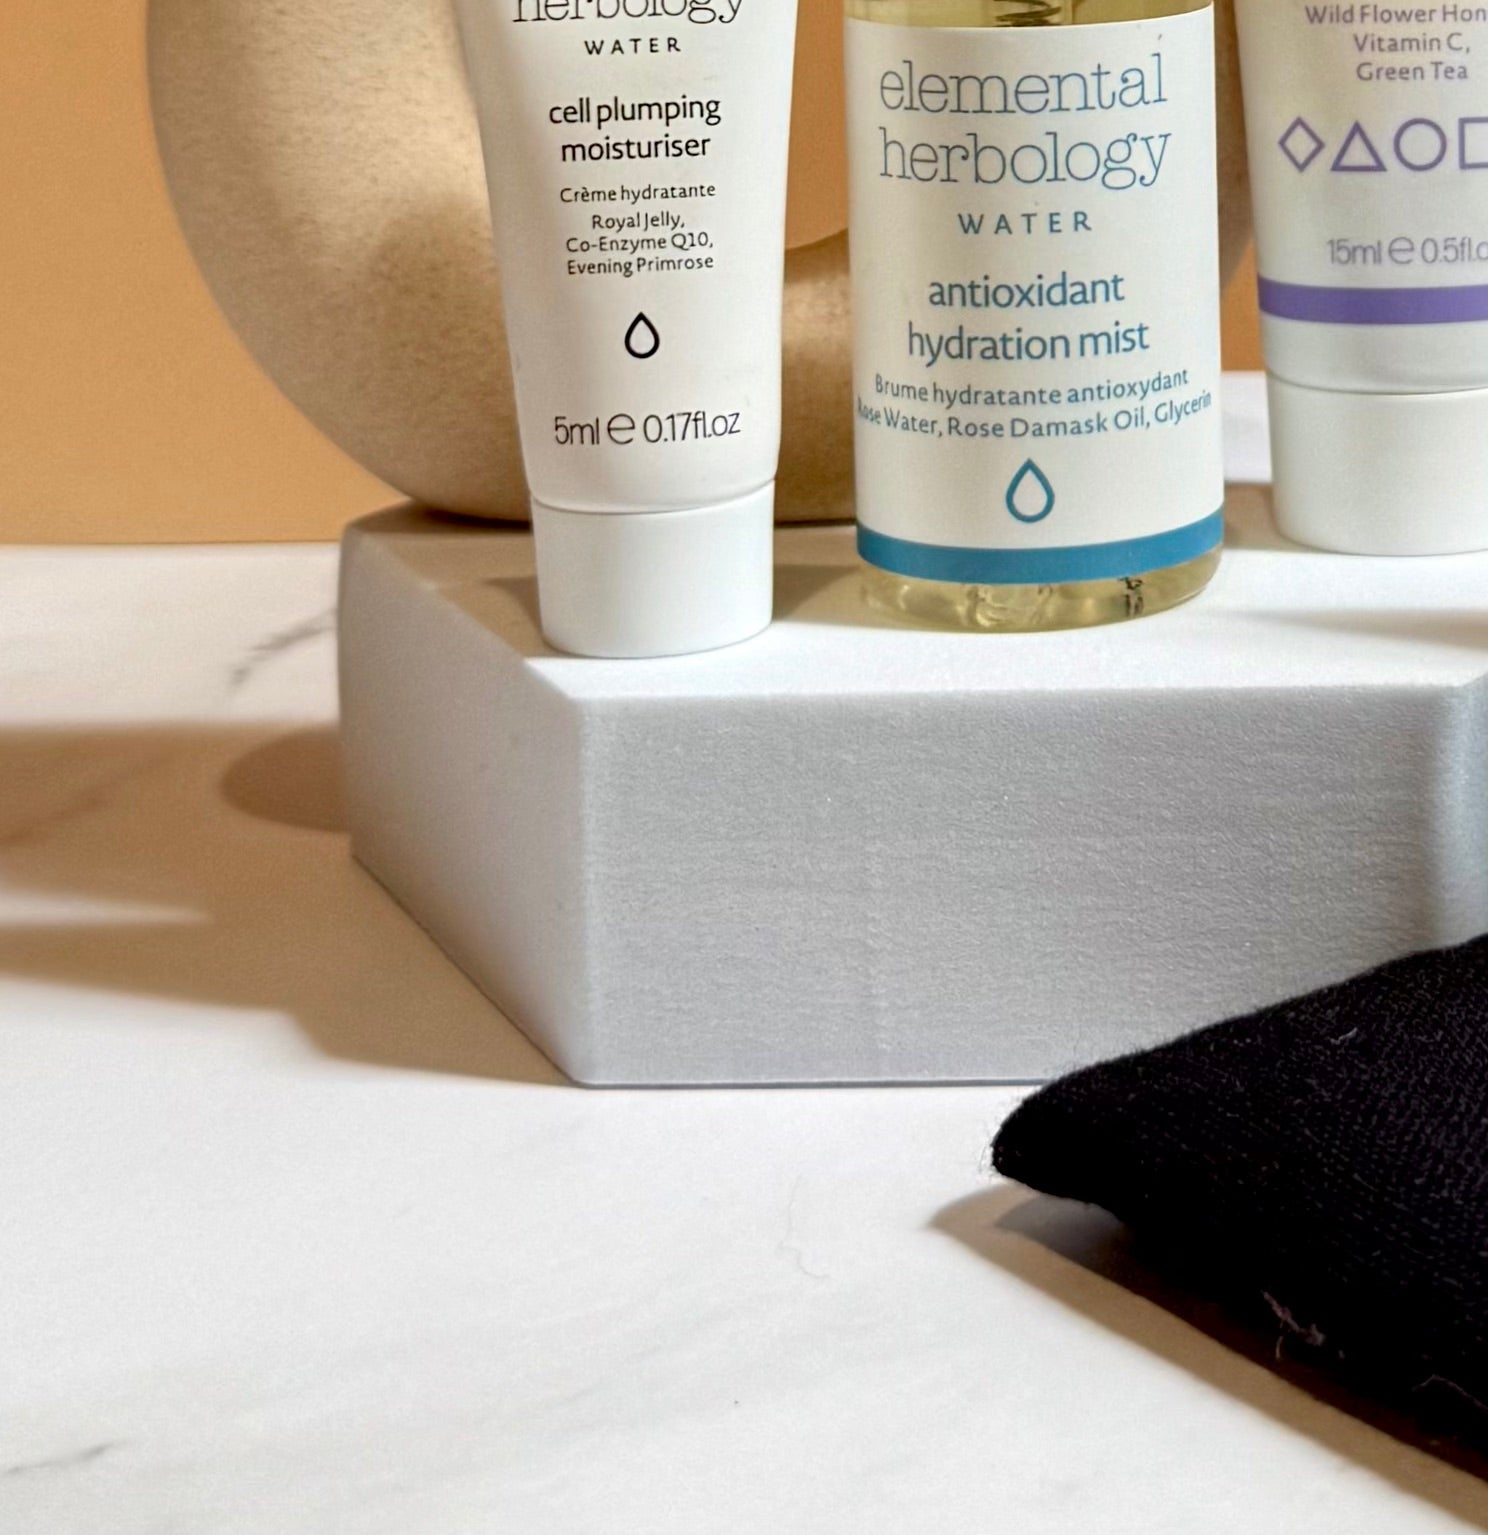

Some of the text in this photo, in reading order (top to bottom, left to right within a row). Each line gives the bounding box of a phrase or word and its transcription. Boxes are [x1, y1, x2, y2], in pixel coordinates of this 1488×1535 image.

[1305, 4, 1354, 24] Wild
[1360, 4, 1437, 24] Flower
[584, 37, 680, 55] WATER
[1353, 32, 1470, 54] Vitamin C,
[880, 52, 1167, 114] elemental
[1356, 61, 1468, 81] Green Tea
[550, 95, 721, 130] cell plumping
[562, 133, 711, 161] moisturiser
[879, 126, 1172, 190] herbology
[560, 184, 715, 205] Crème hydratante
[592, 211, 684, 233] Royal Jelly,
[957, 211, 1091, 235] WATER
[566, 232, 713, 255] Co-Enzyme Q10,
[1327, 238, 1382, 266] 15ml
[568, 257, 713, 278] Evening Primrose
[929, 271, 1125, 308] antioxidant
[909, 321, 1150, 368] hydration mist
[876, 369, 1189, 410] Brume hydratante antioxydant
[555, 416, 599, 445] 5ml
[884, 407, 943, 438] Water,
[948, 416, 1004, 438] Rose
[1011, 412, 1108, 437] Damask
[1114, 406, 1150, 430] Oil,
